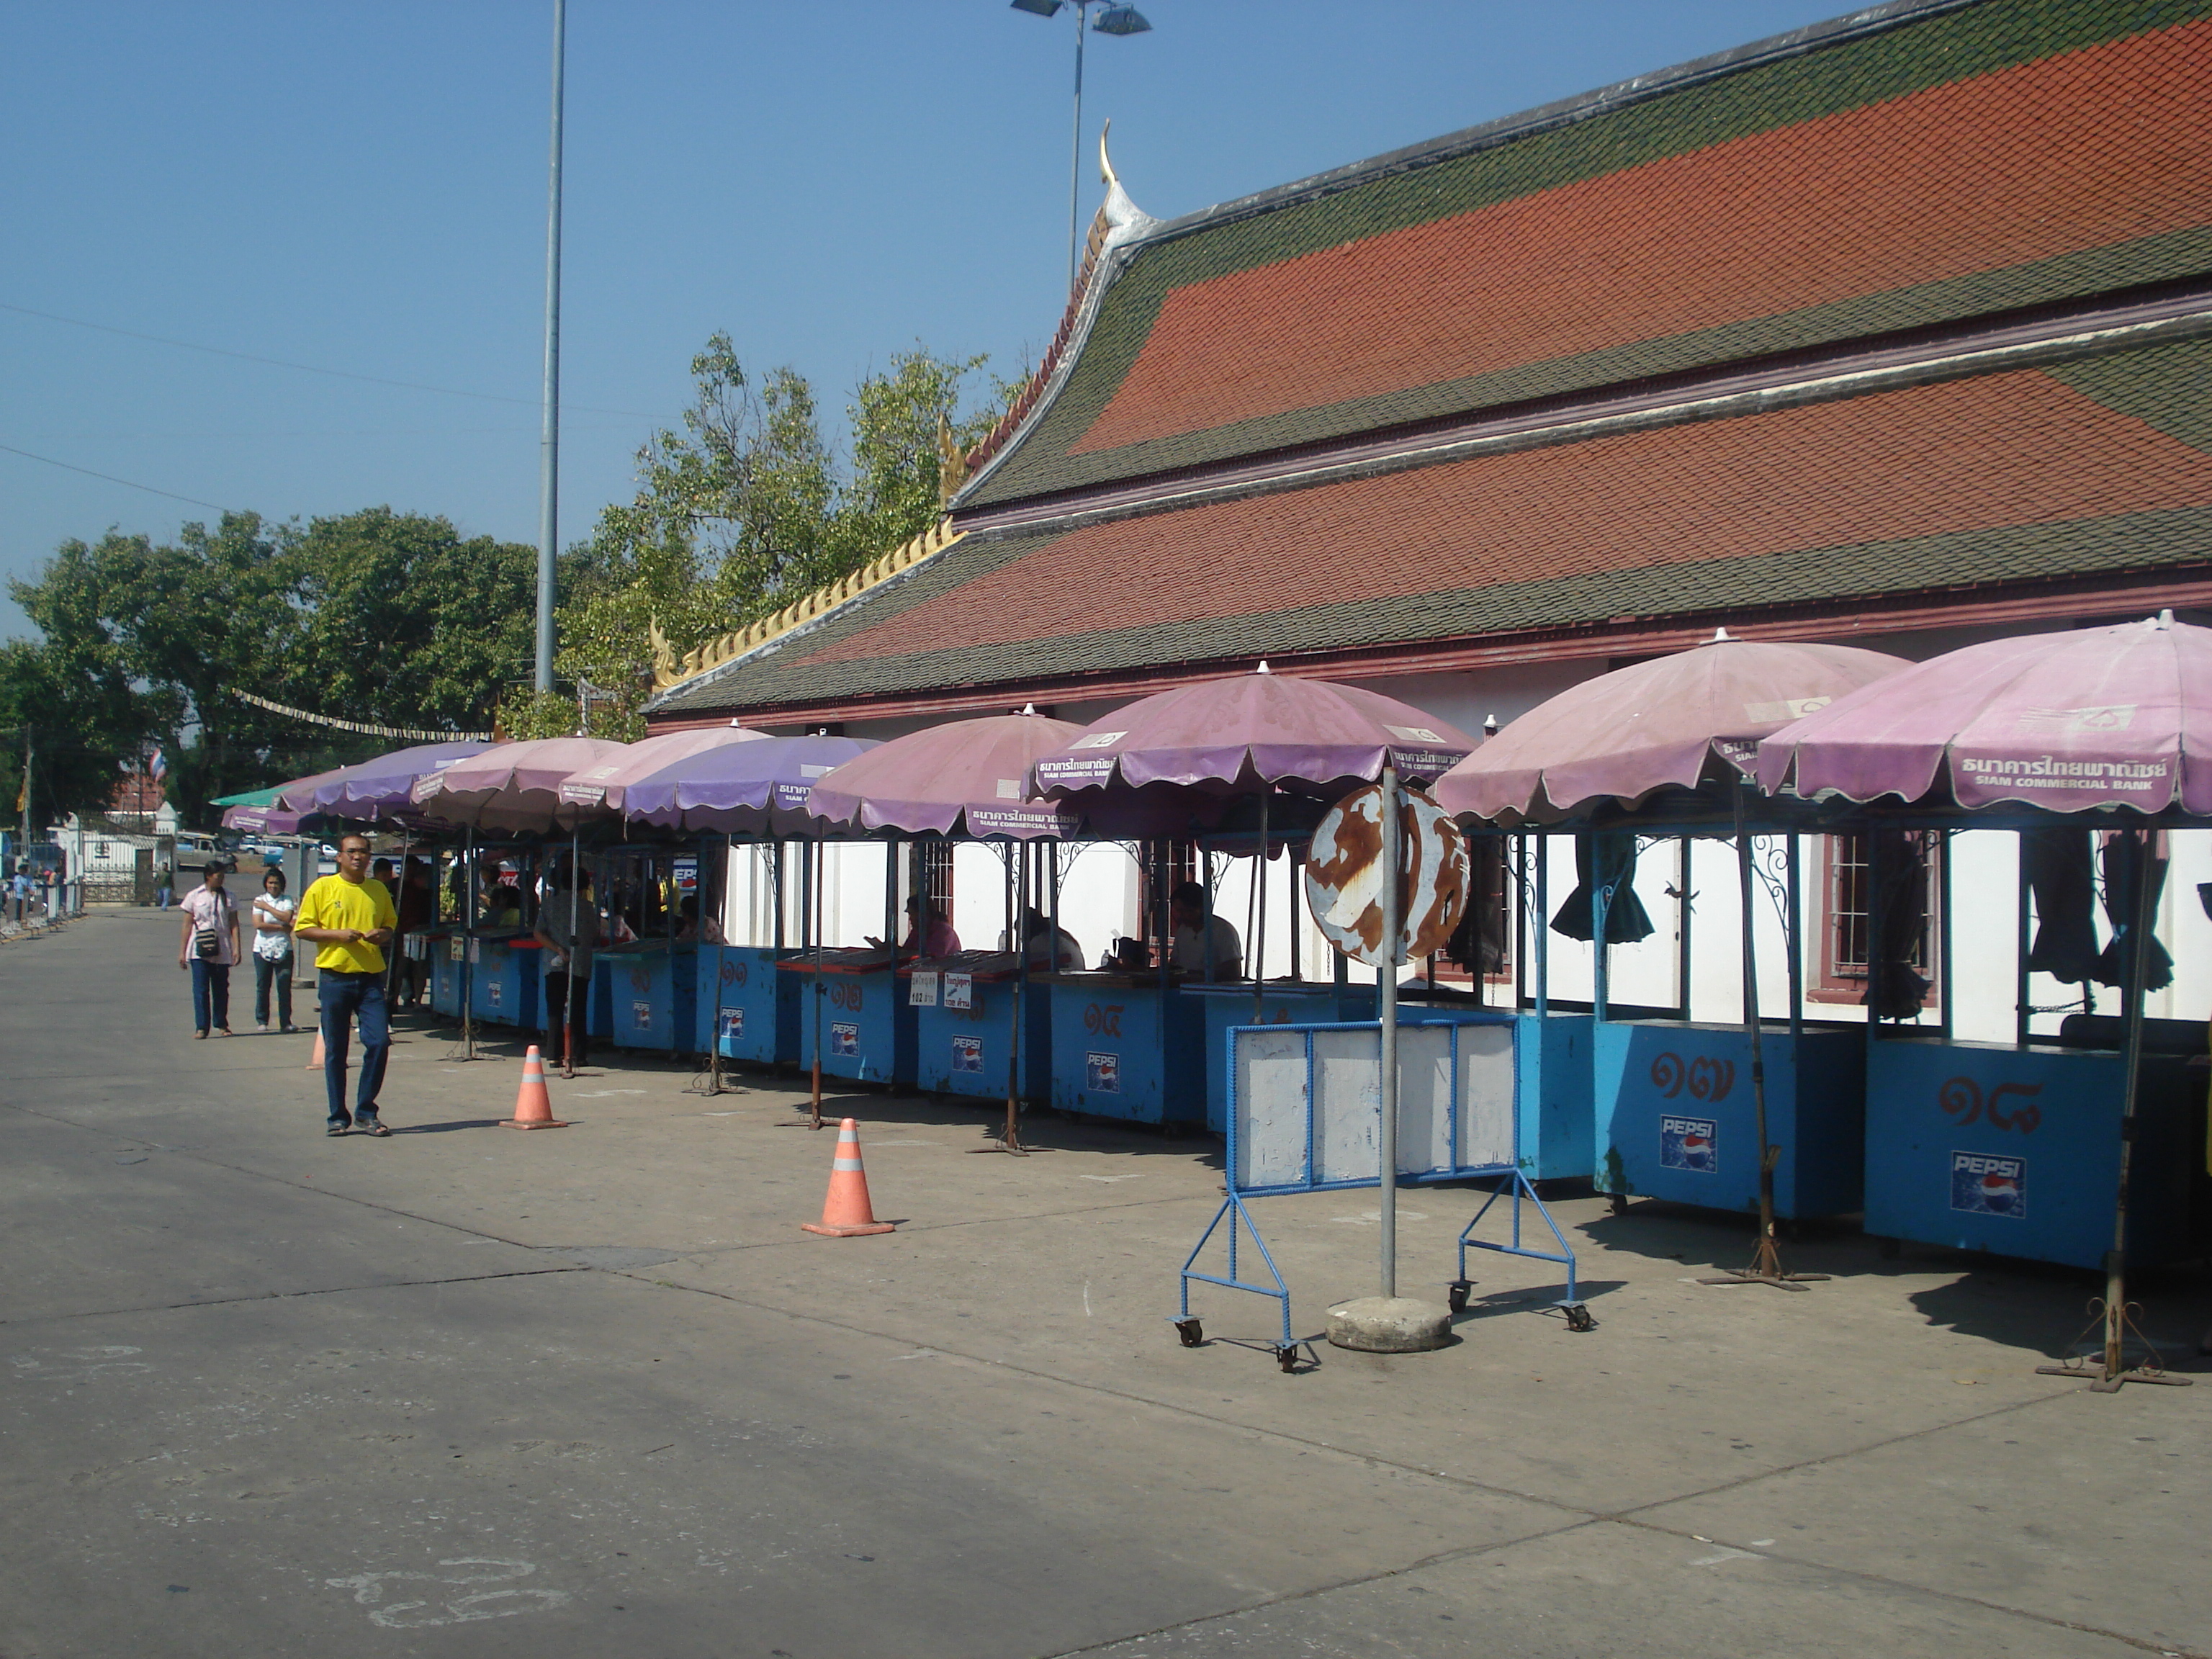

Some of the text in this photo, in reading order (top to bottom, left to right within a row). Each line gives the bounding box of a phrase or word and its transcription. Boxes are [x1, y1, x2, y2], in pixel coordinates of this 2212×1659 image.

[1962, 755, 2167, 778] ธนาคารไทยพาณิชย์
[1974, 775, 2153, 790] SIAM COMMERCIAL BANK
[973, 809, 1079, 824] ธนาคารไทยพาณิชย์
[1000, 821, 1048, 830] COMMERCIAL
[912, 992, 922, 1002] 102
[721, 1008, 743, 1019] PEPSI
[832, 1024, 858, 1035] PEPSI
[953, 1038, 981, 1050] PEPSI
[1088, 1054, 1116, 1067] PEPSI
[1651, 1052, 1735, 1102] ๑๗
[1939, 1076, 2044, 1135] ๑๘
[1663, 1119, 1713, 1138] PEPSI
[1954, 1156, 2020, 1178] PEPSI
